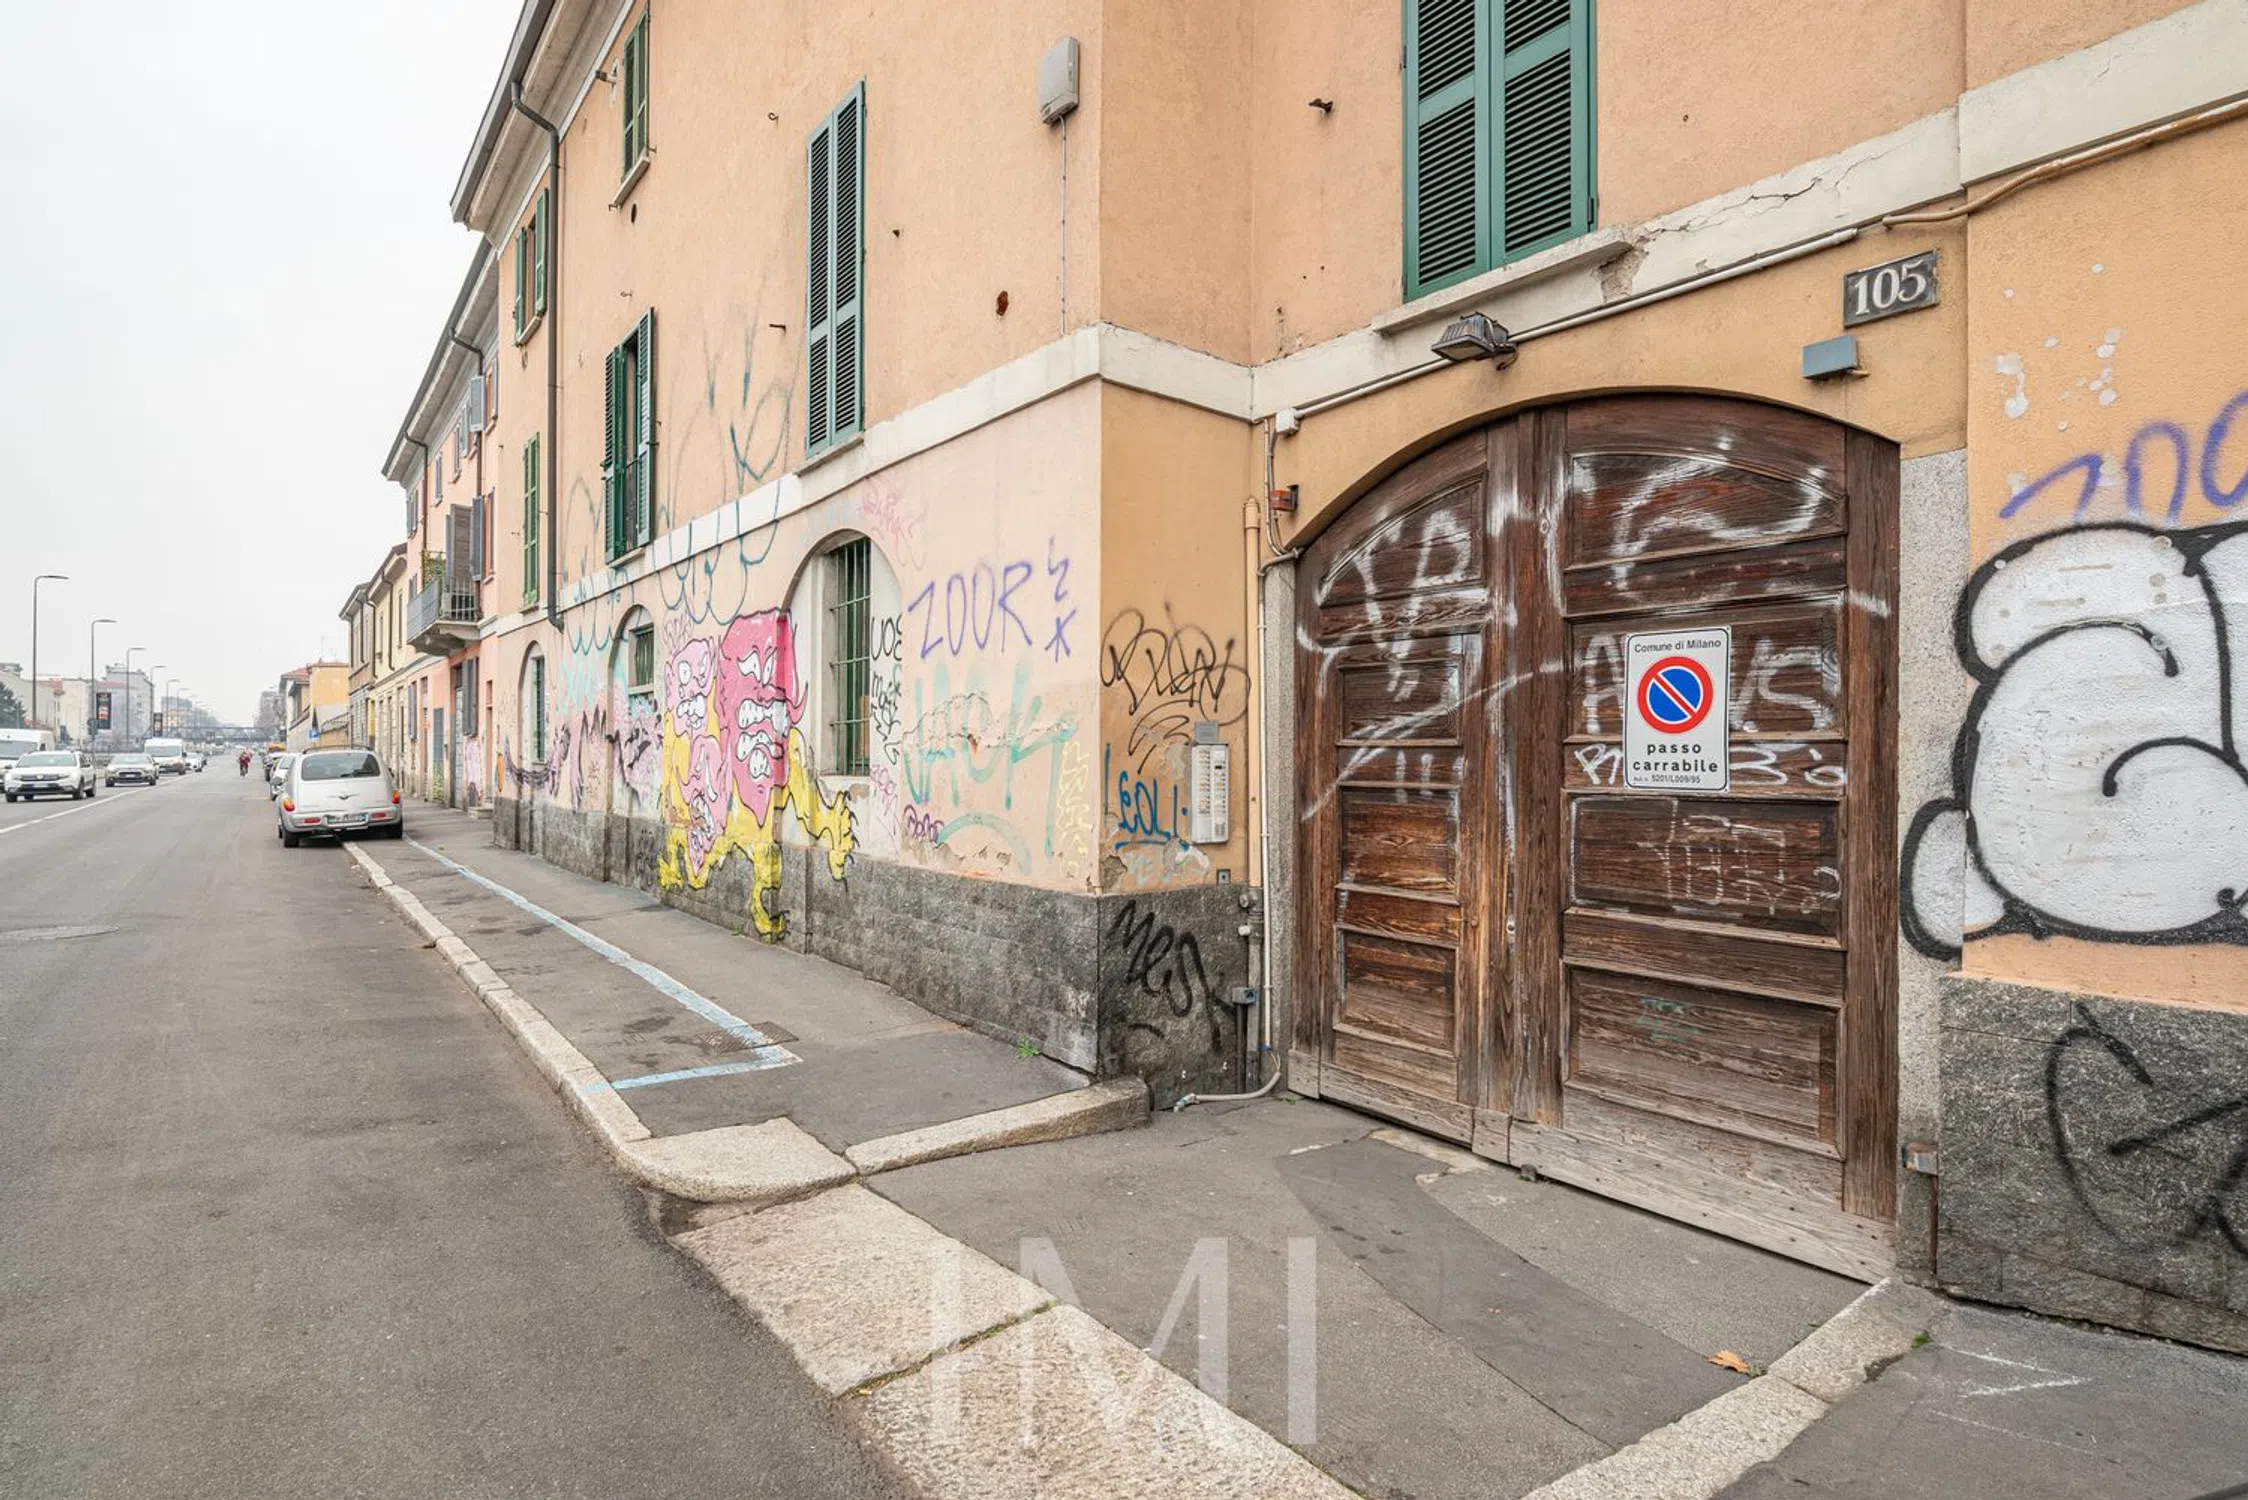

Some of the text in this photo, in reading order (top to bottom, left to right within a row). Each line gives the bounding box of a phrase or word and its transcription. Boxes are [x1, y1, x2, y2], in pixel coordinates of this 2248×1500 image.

[1853, 258, 1927, 316] 105
[1634, 639, 1722, 653] Comune di Milano
[1646, 743, 1702, 755] passo
[1633, 758, 1719, 773] carrabile
